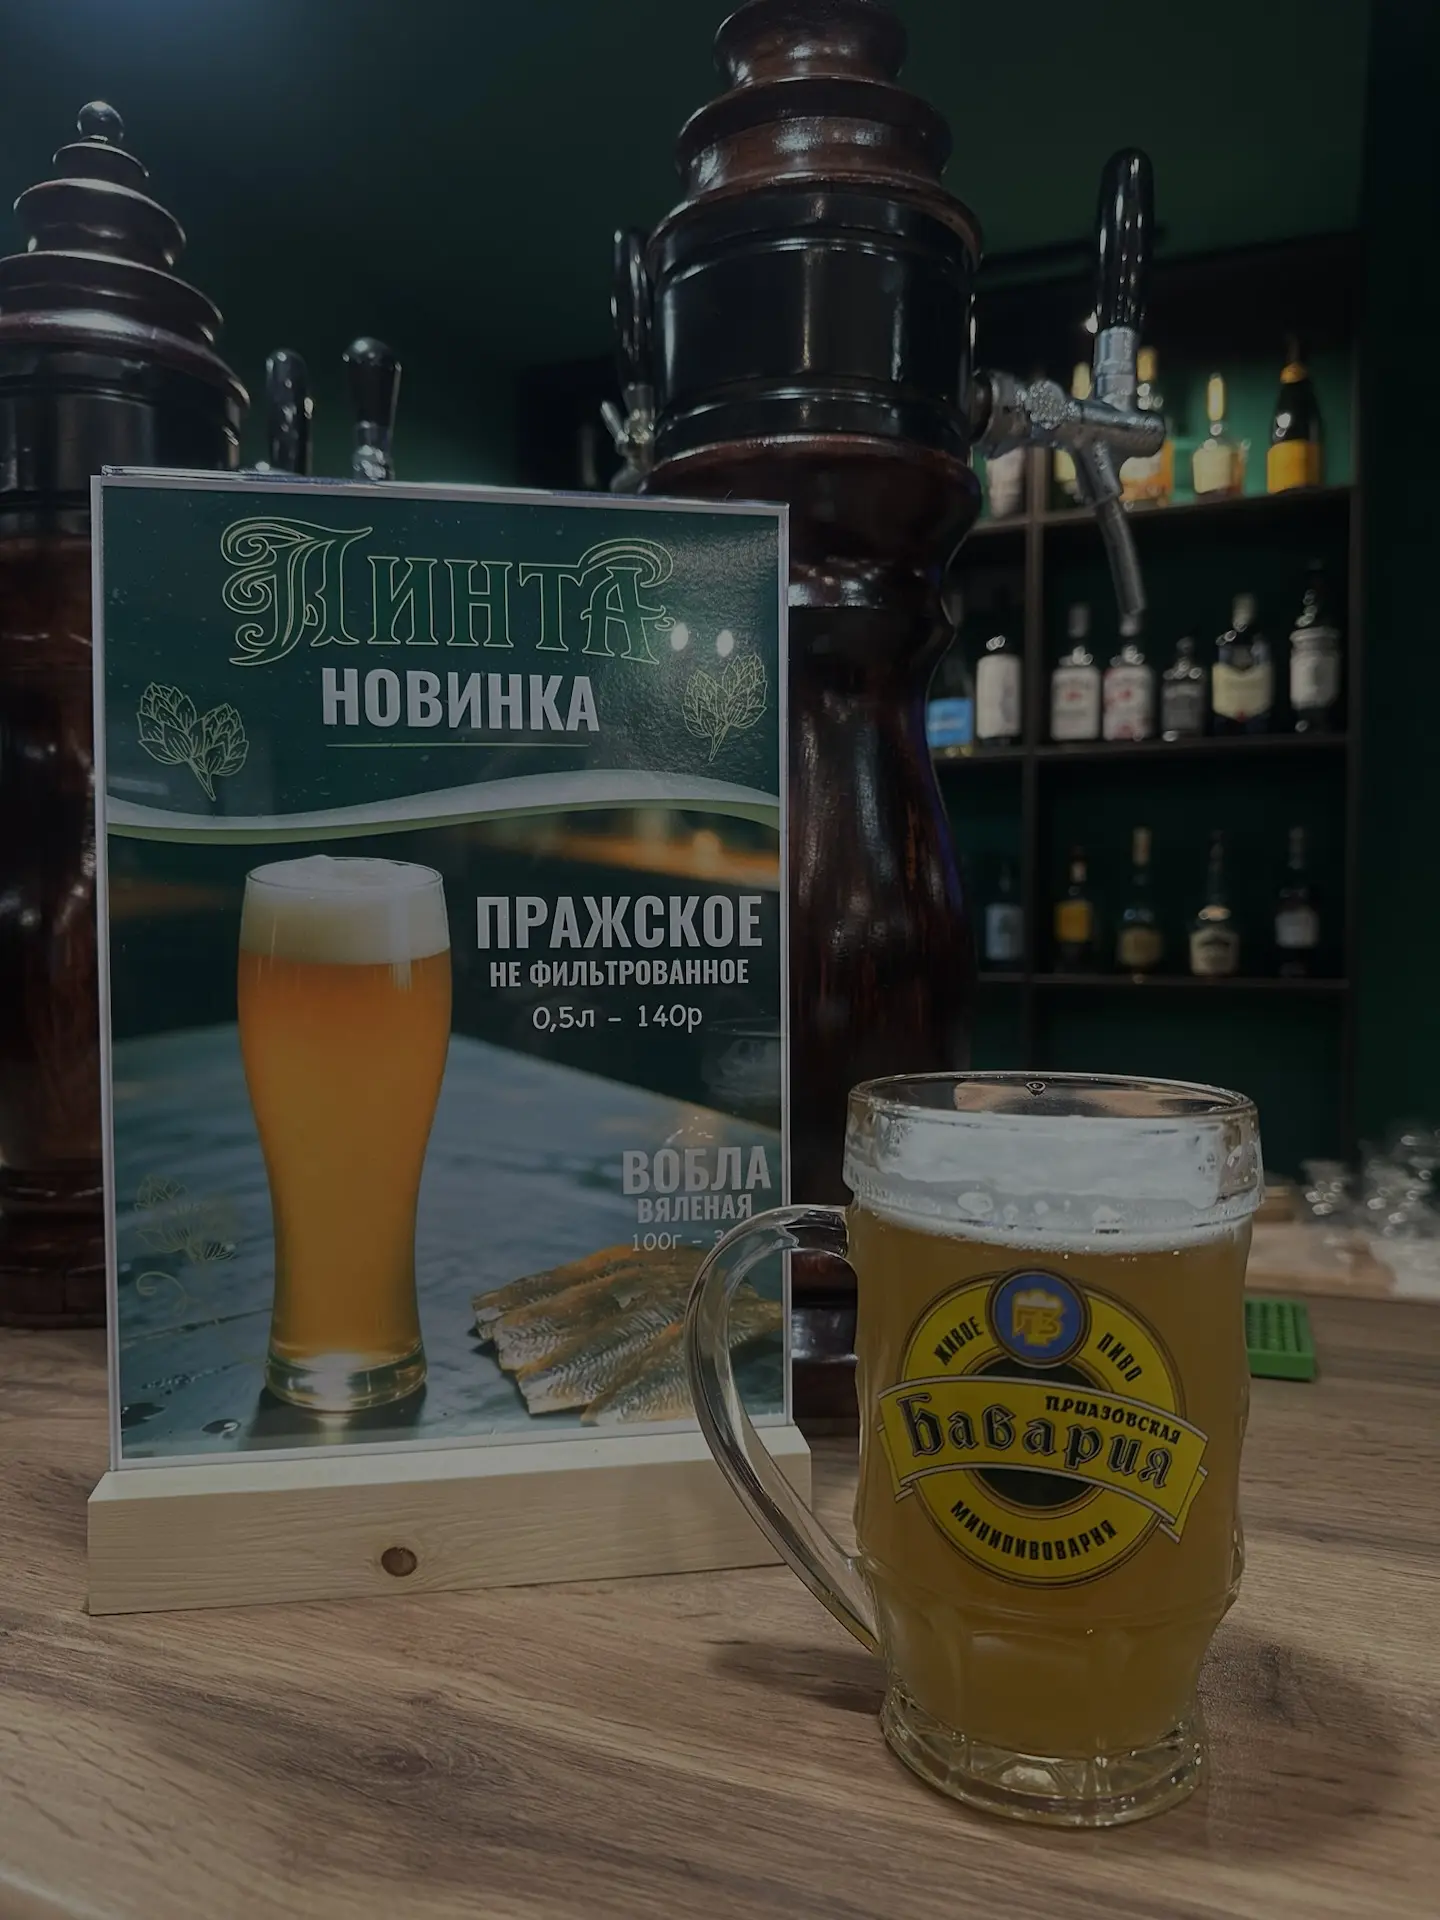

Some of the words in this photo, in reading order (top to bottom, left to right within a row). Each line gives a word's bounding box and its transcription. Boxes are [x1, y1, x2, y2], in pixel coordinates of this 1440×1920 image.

[220, 515, 676, 667] ПИНТА
[321, 667, 601, 733] НОВИНКА
[476, 895, 763, 950] ПРАЖСКОЕ
[490, 961, 522, 988] НЕ
[529, 958, 749, 988] ФИЛЬТРОВАННОЕ
[532, 1006, 595, 1033] 0,5л
[638, 1004, 703, 1033] 140р
[622, 1146, 772, 1195] ВОБЛА
[637, 1194, 752, 1224] ВЯЛЕНАЯ
[632, 1232, 682, 1252] 100г
[934, 1316, 983, 1366] ЖИВОЕ
[1097, 1332, 1142, 1382] ПИВО
[897, 1393, 1173, 1489] Бавария
[1045, 1395, 1181, 1445] ПРИАЗОВСКАЯ
[951, 1500, 1118, 1561] МИНИПИВОВАРНЯ
